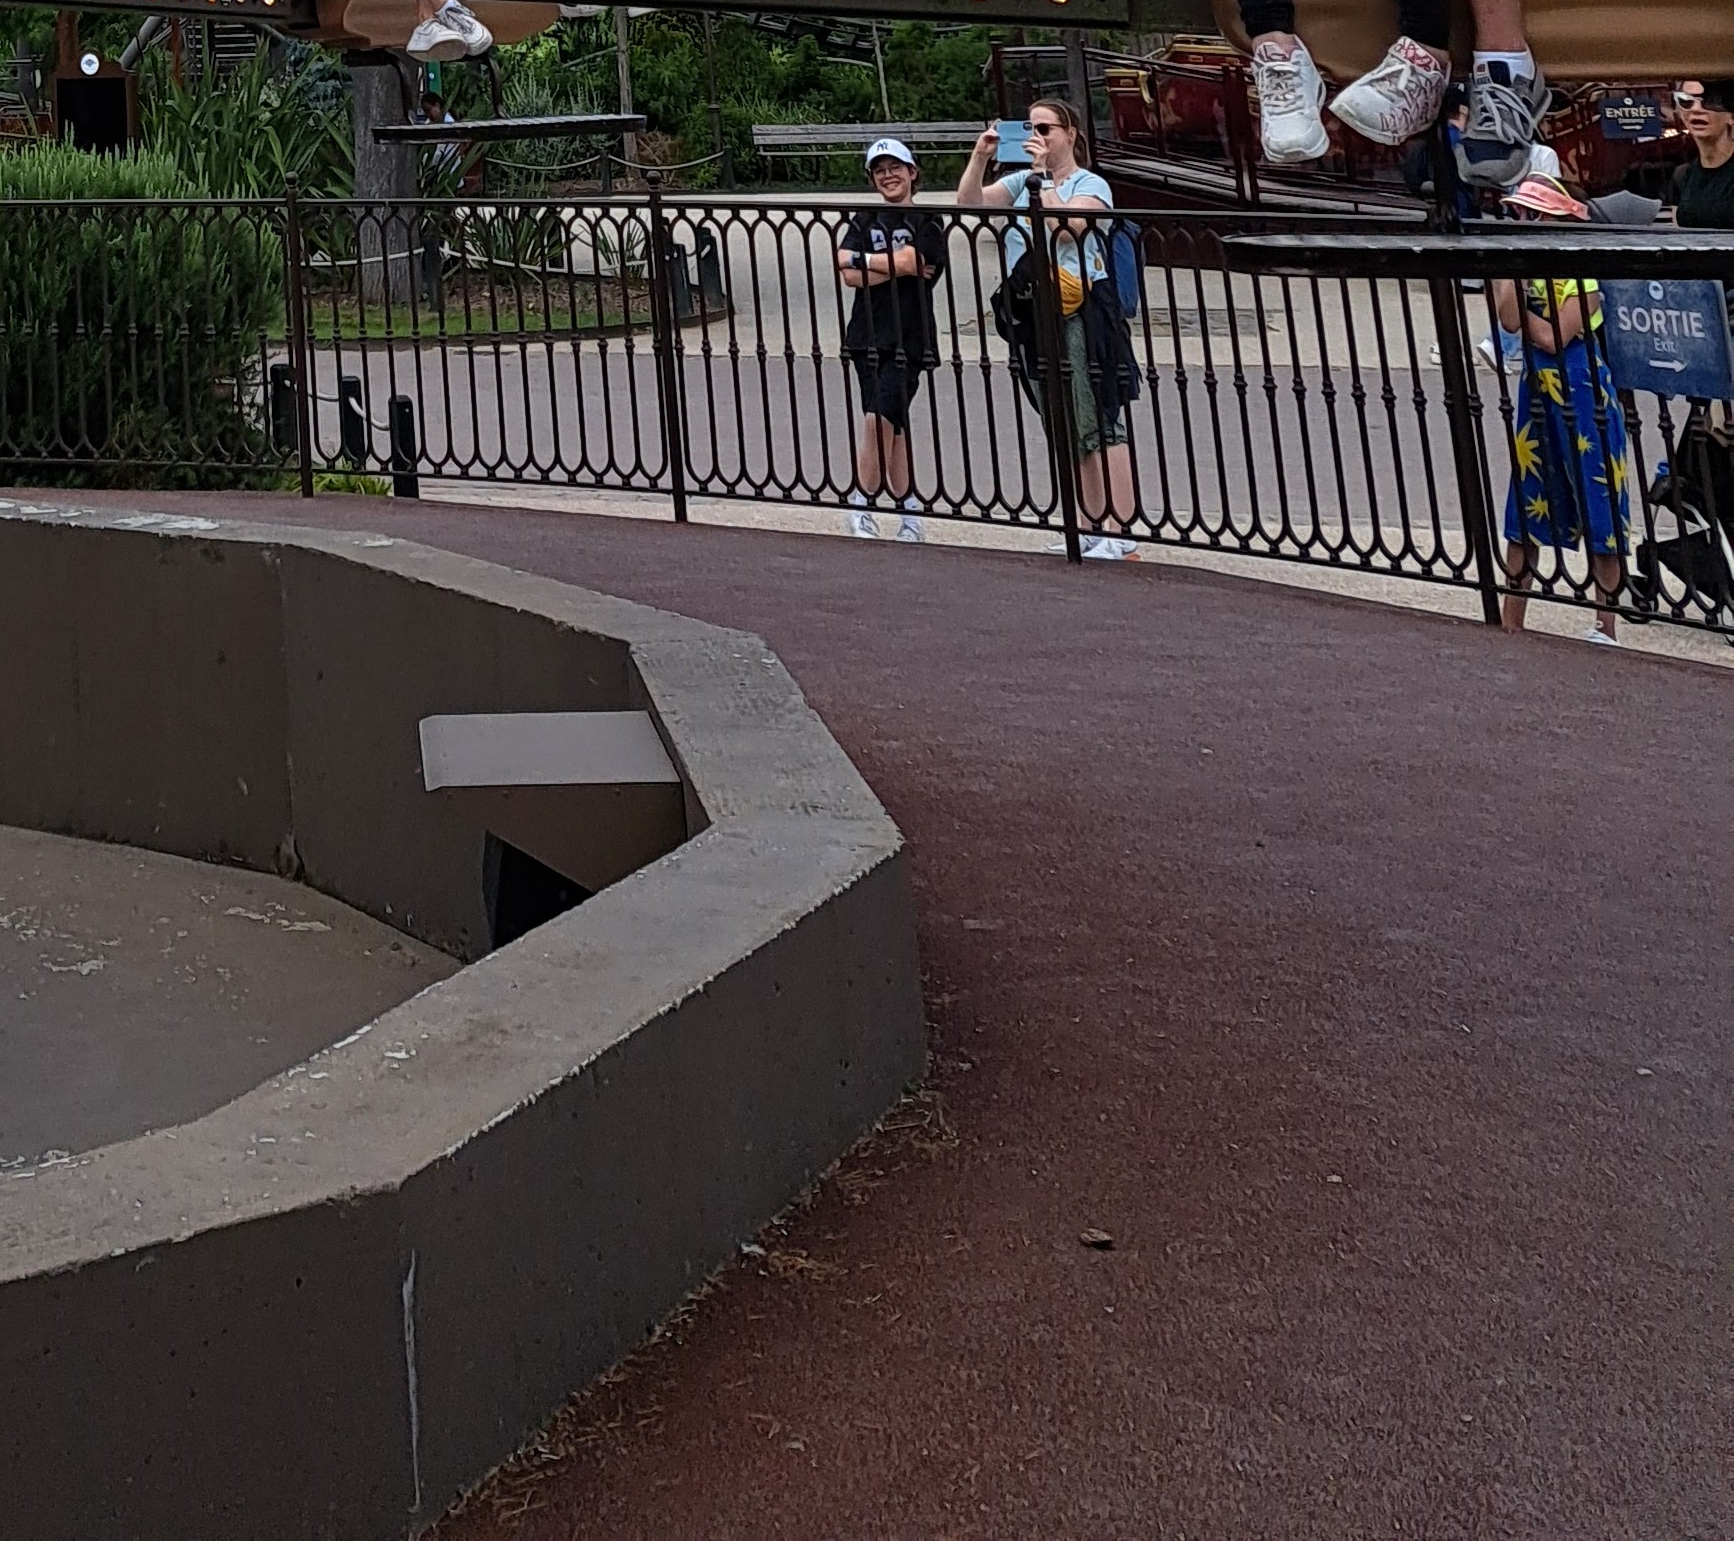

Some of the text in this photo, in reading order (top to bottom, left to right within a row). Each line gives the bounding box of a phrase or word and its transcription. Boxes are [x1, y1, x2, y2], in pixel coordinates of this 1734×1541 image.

[1605, 104, 1656, 118] ENTRÉE
[1617, 305, 1706, 338] SORTIE
[1653, 337, 1677, 353] Exit
